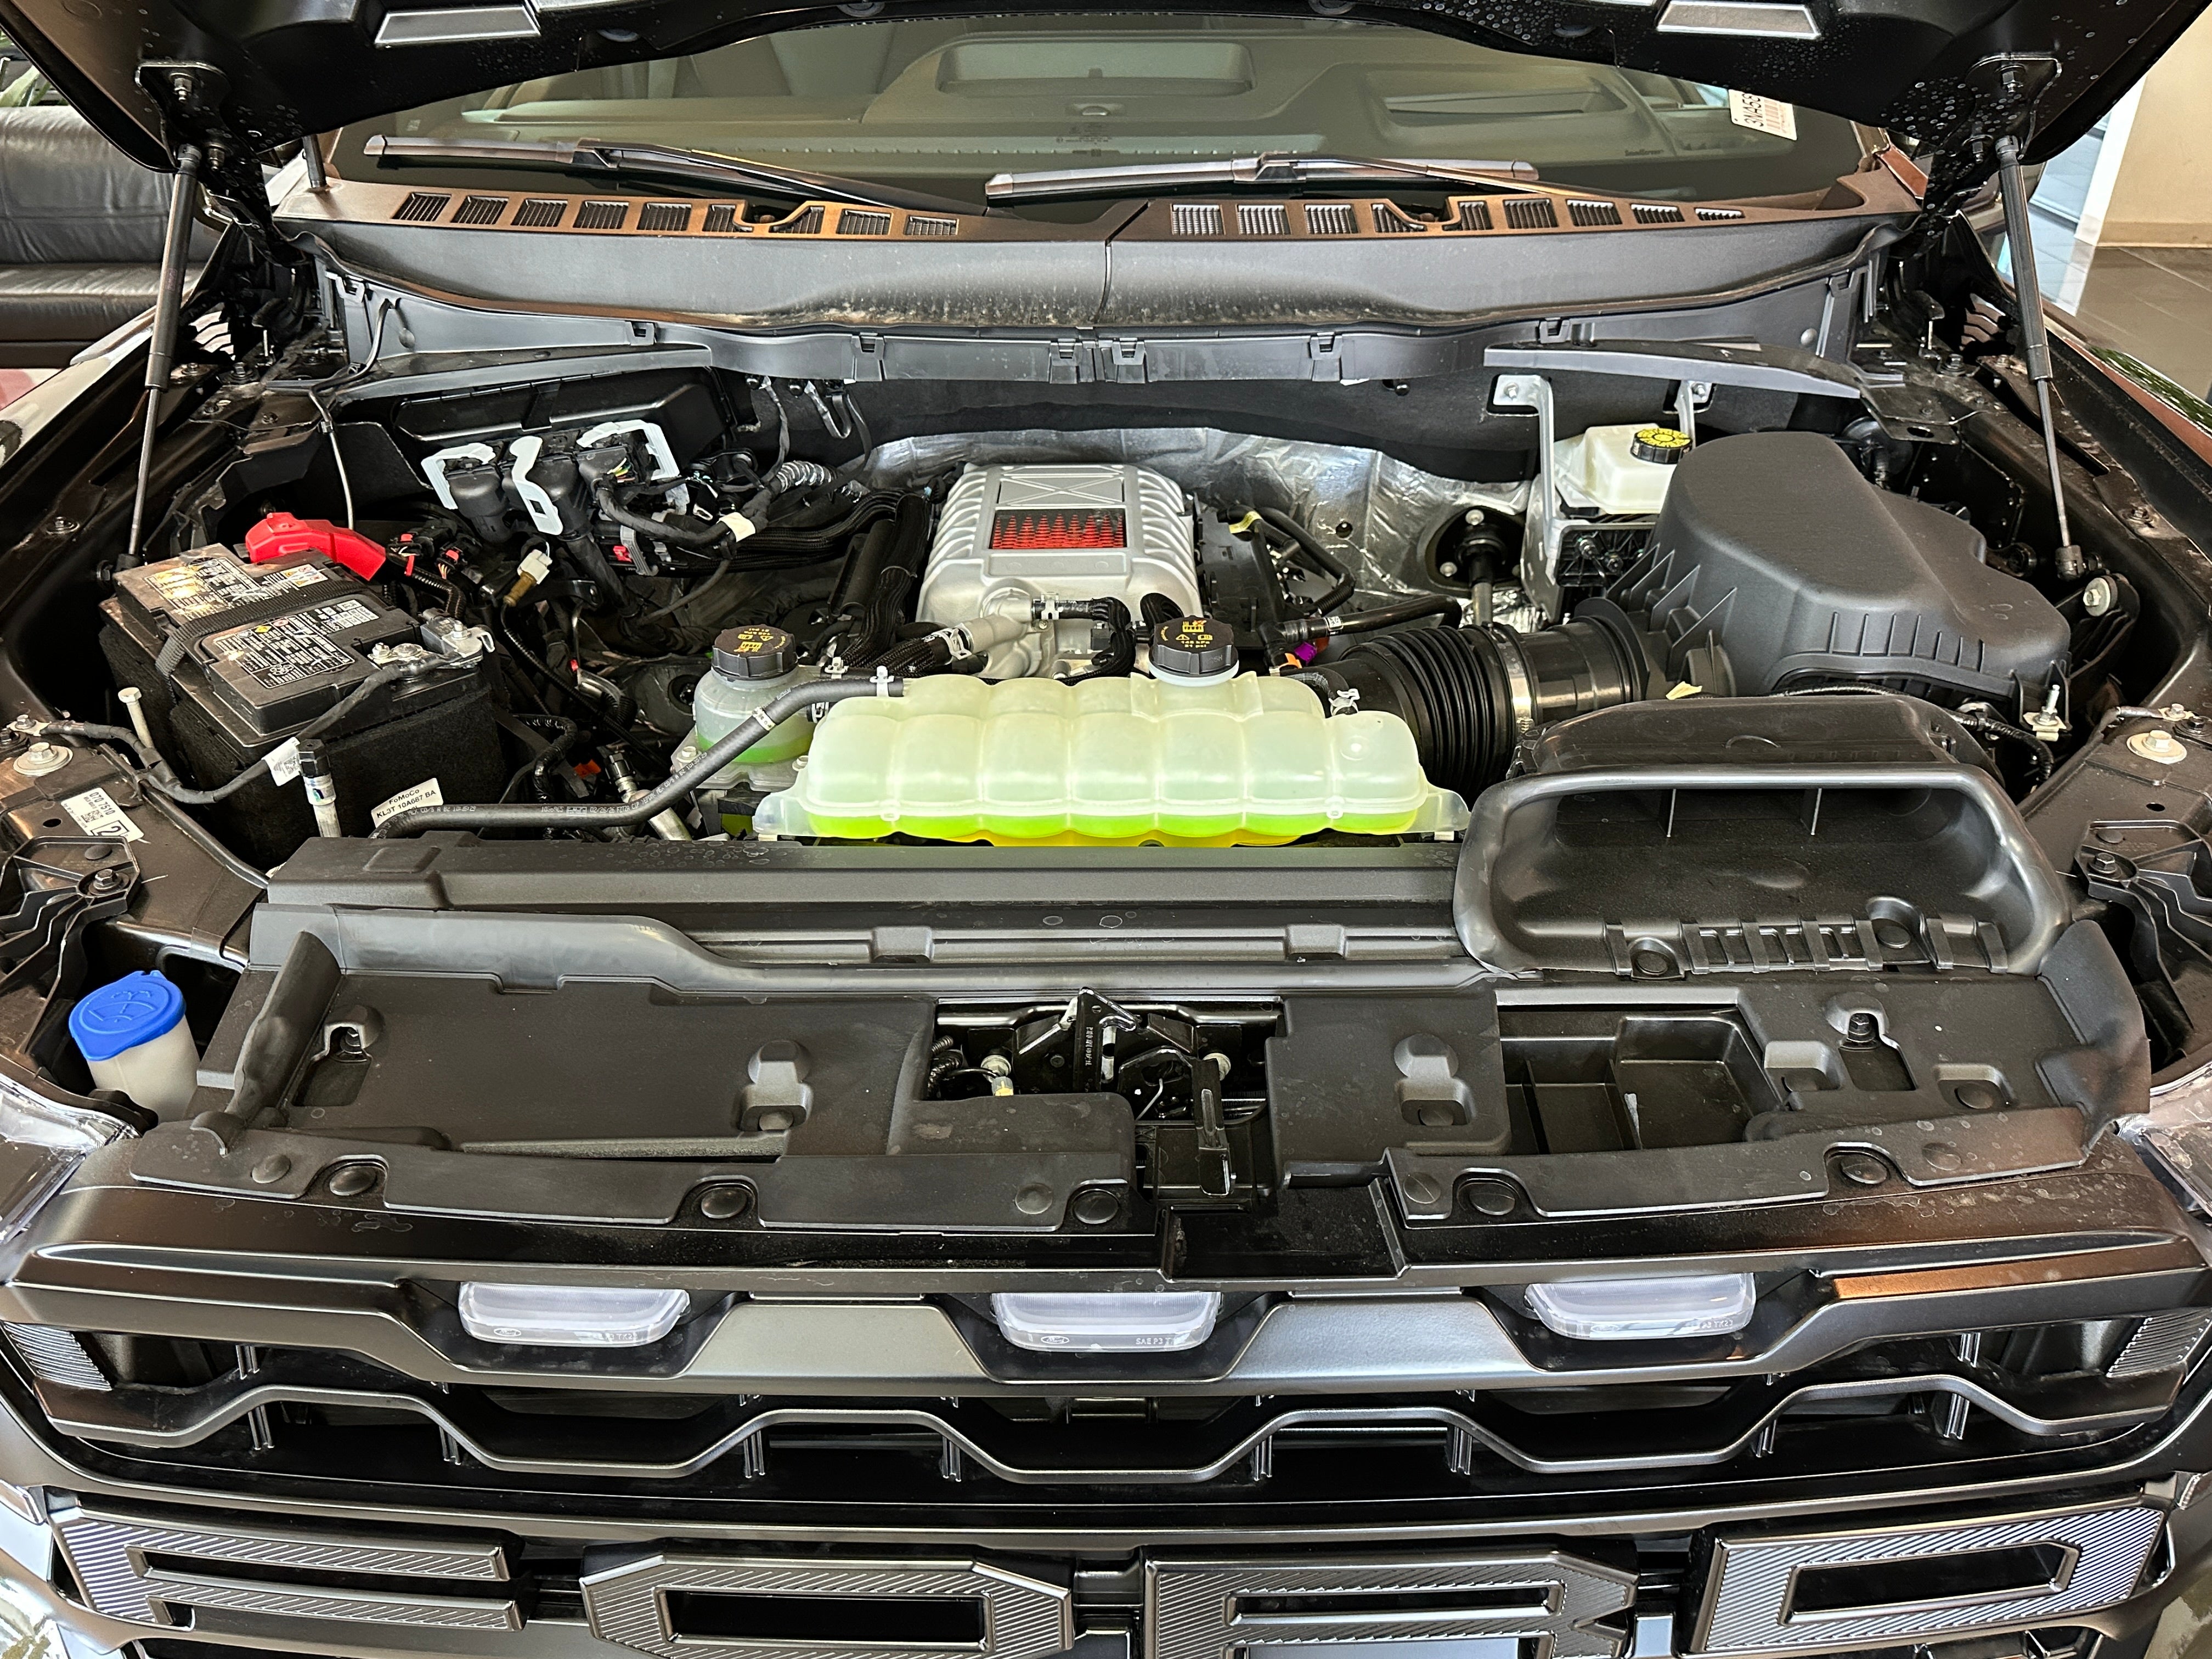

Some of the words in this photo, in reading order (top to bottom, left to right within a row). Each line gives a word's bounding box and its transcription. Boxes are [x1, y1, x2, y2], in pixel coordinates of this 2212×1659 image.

[376, 806, 396, 819] KL3T
[425, 789, 437, 798] BA
[389, 788, 420, 804] FoMoCo
